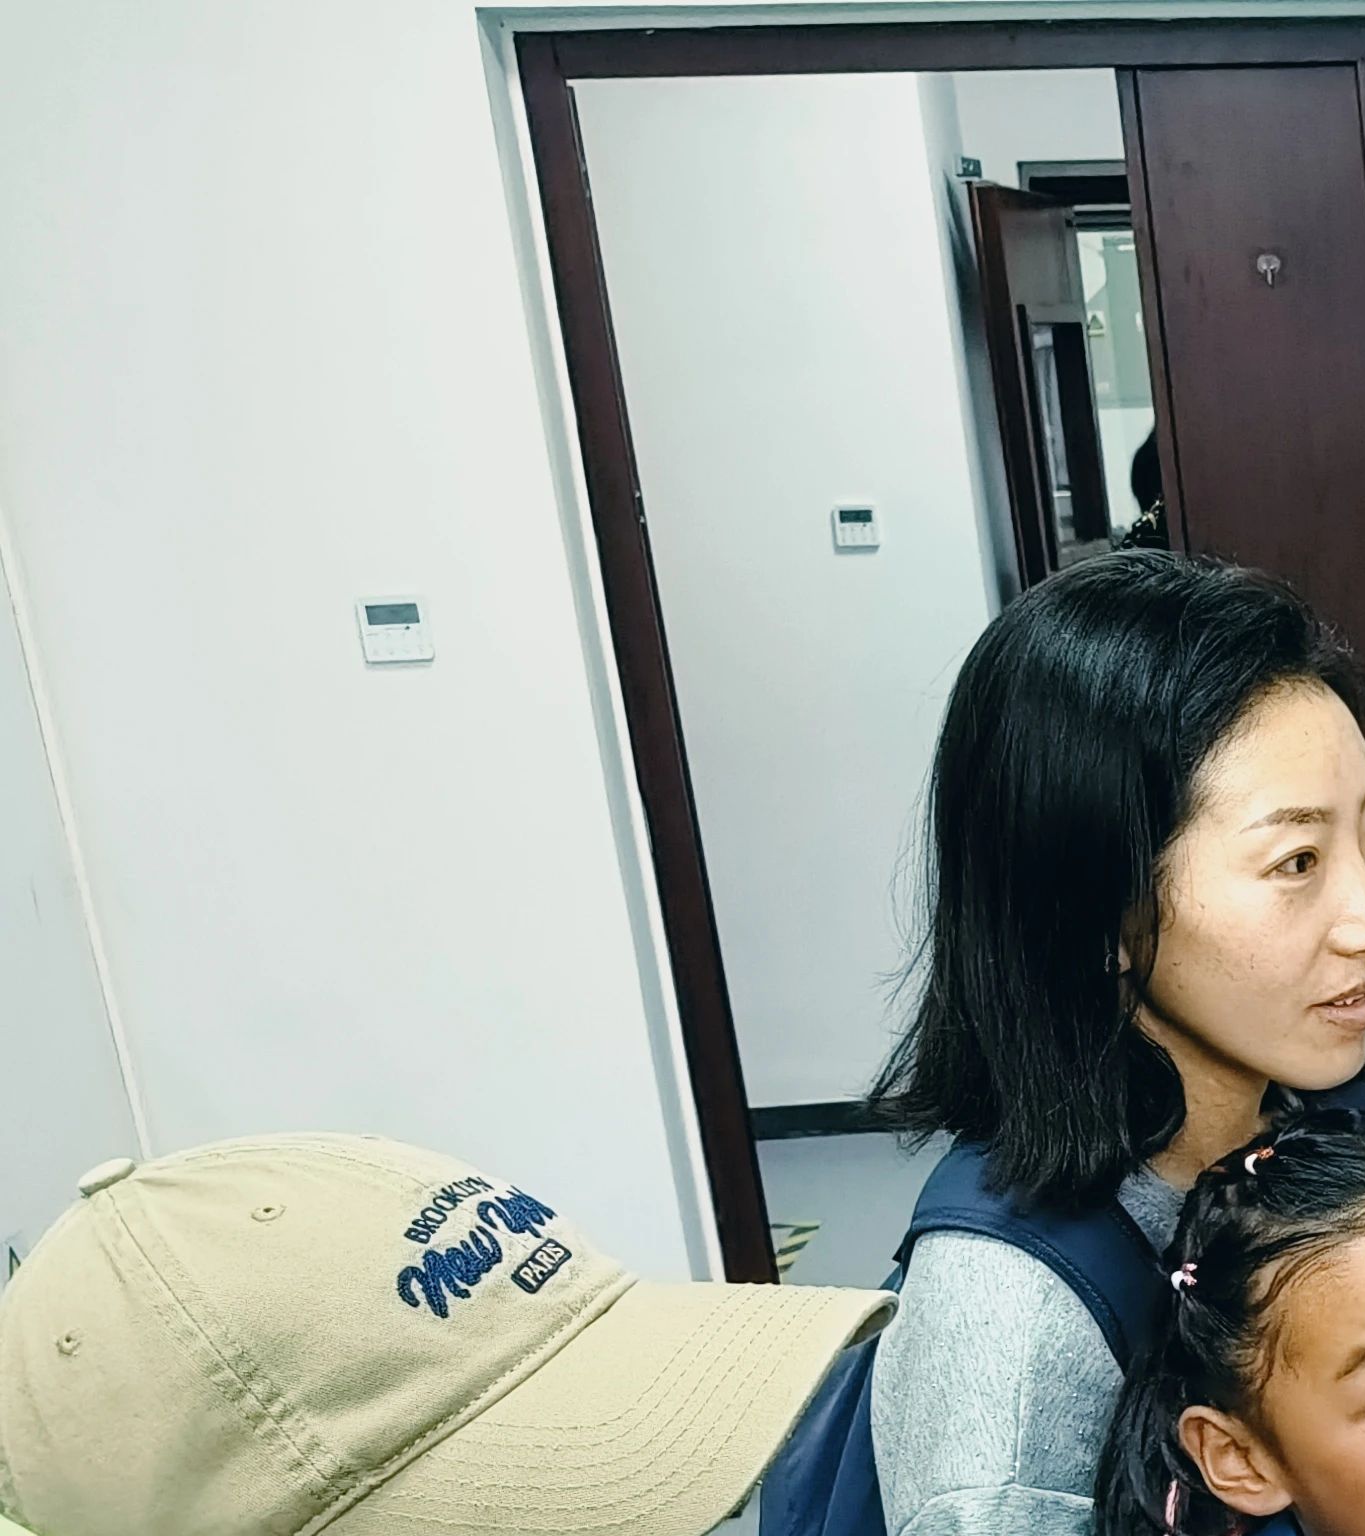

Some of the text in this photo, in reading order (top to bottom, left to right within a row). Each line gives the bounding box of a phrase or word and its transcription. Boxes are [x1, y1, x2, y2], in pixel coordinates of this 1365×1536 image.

[404, 1176, 494, 1244] BROOKLYN
[397, 1226, 503, 1318] New
[518, 1242, 566, 1288] PARIS
